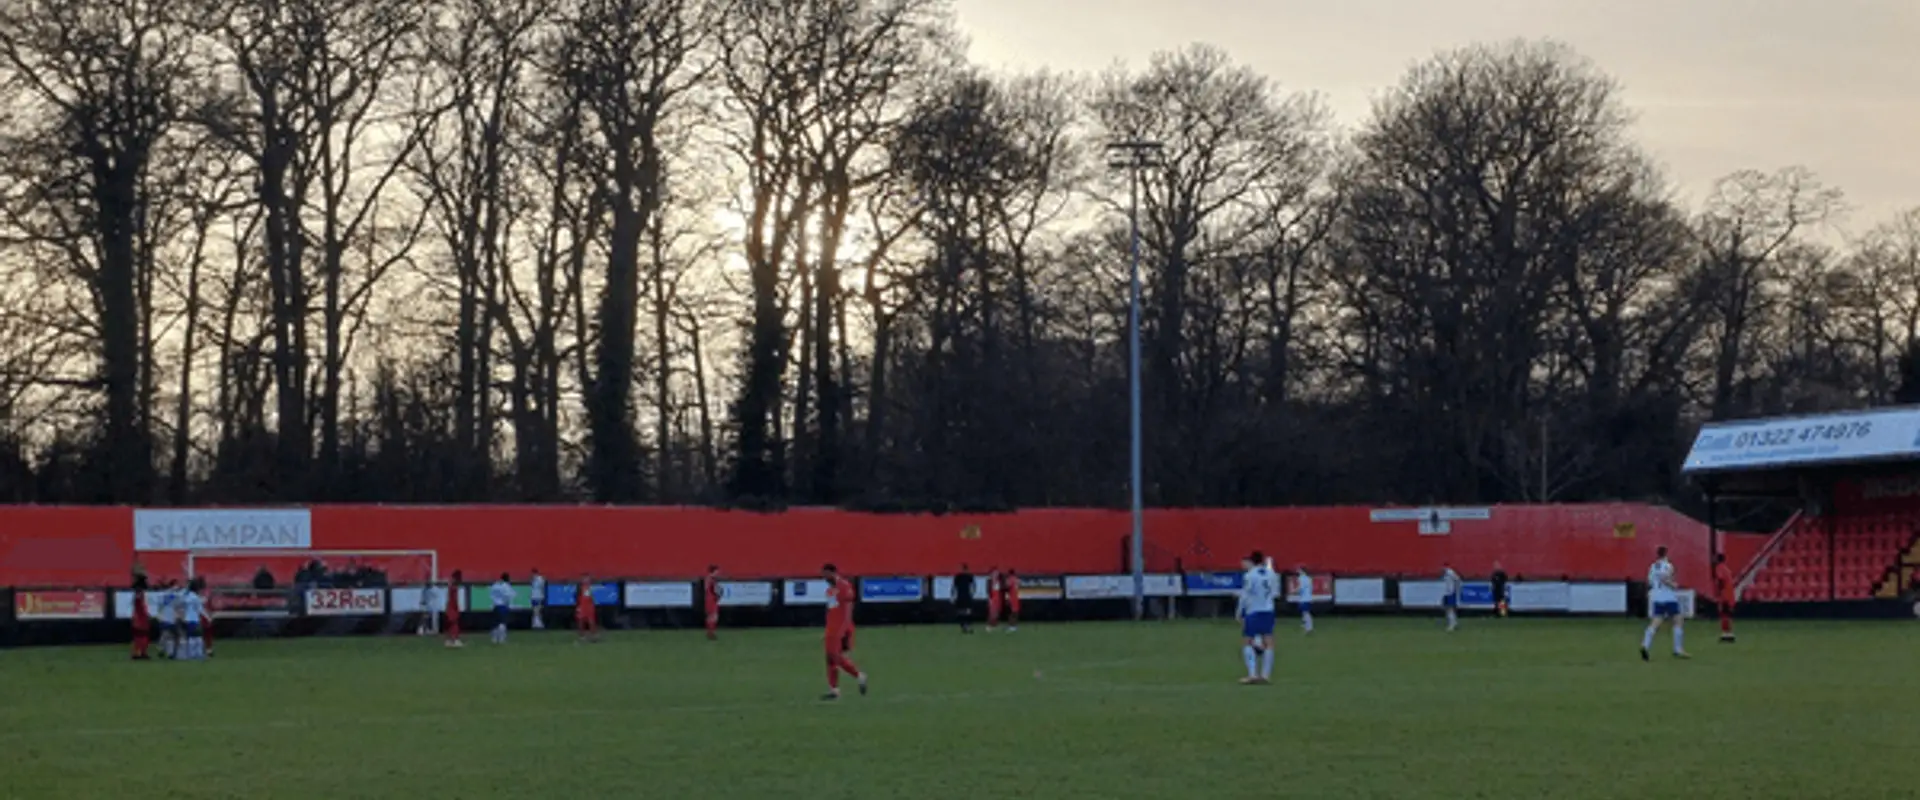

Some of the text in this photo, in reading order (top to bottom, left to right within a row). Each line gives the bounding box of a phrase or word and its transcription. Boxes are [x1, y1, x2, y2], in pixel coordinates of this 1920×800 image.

[1735, 429, 1795, 448] 01322
[148, 524, 299, 547] SHAMPAN
[311, 590, 379, 609] 32Red
